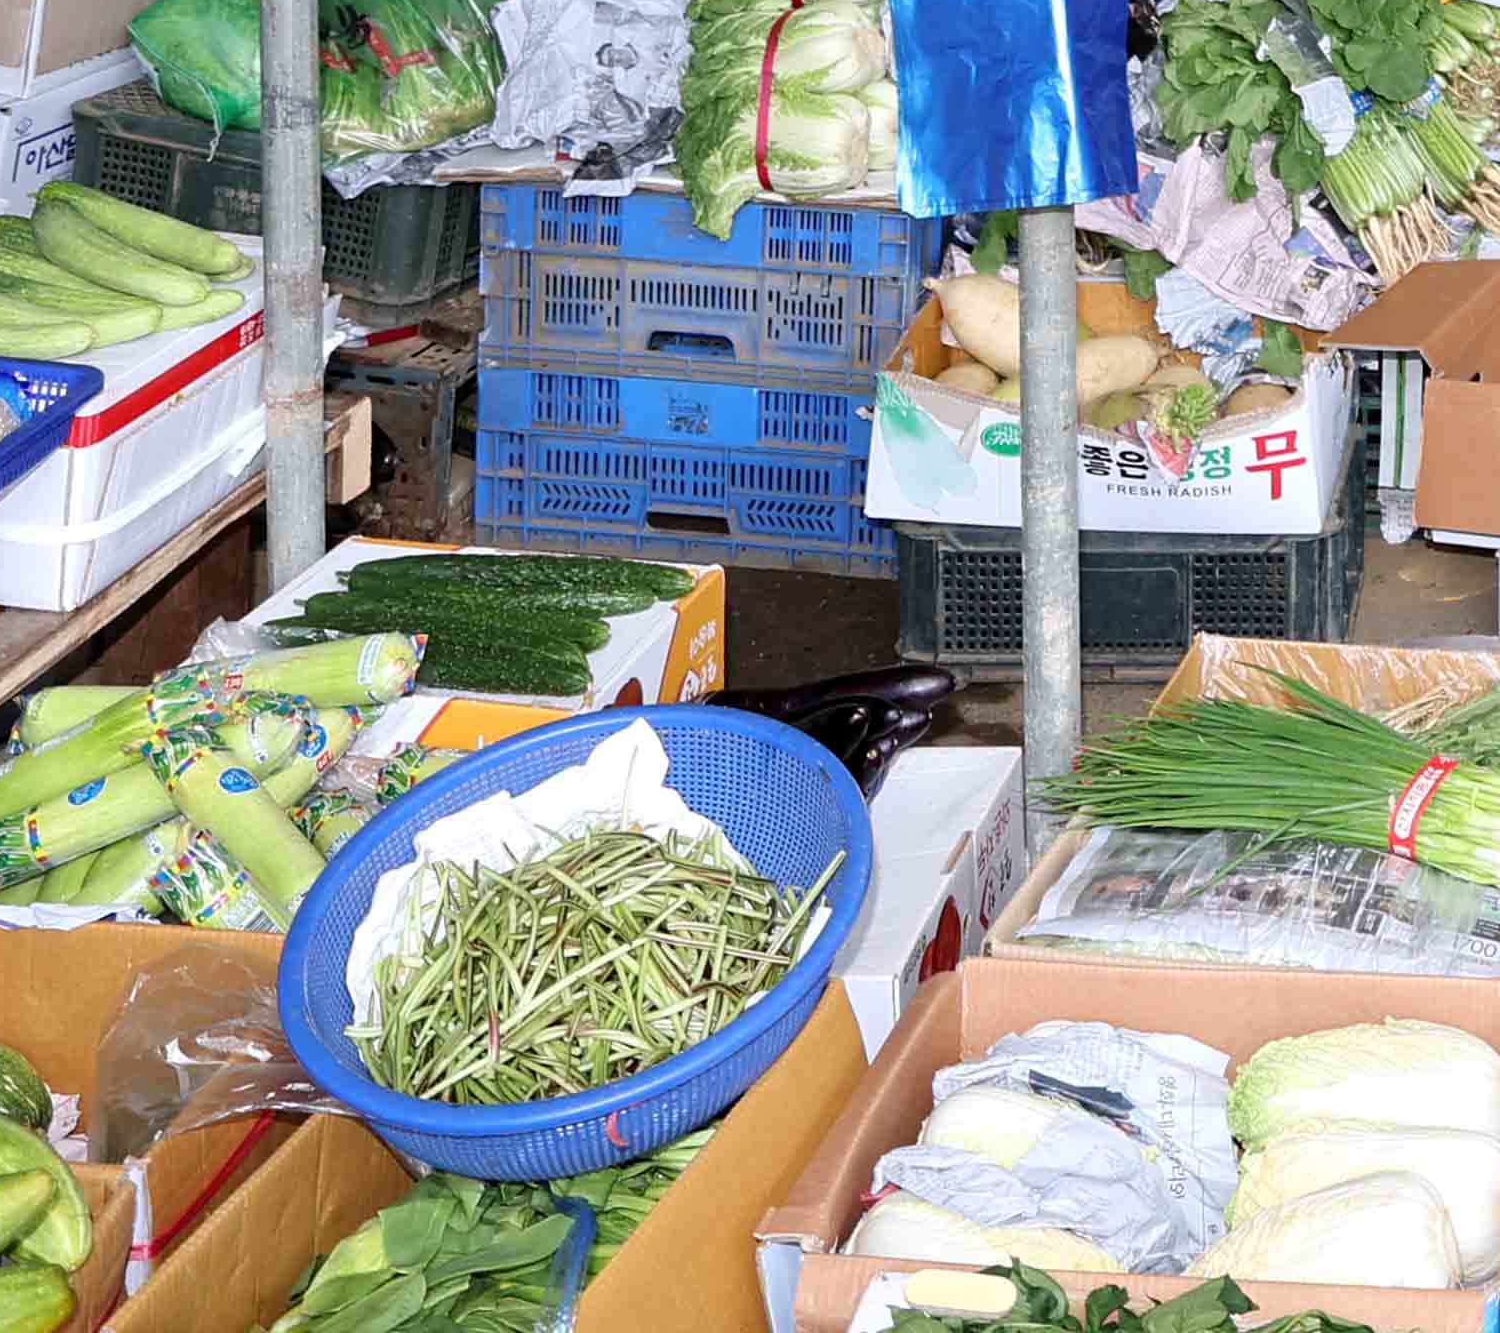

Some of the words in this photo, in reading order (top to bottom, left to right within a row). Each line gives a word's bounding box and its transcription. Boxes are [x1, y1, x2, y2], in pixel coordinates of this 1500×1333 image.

[1078, 443, 1149, 481] 좋은
[1244, 429, 1307, 501] 무
[1106, 483, 1162, 498] FRESH
[1168, 484, 1233, 499] RADISH
